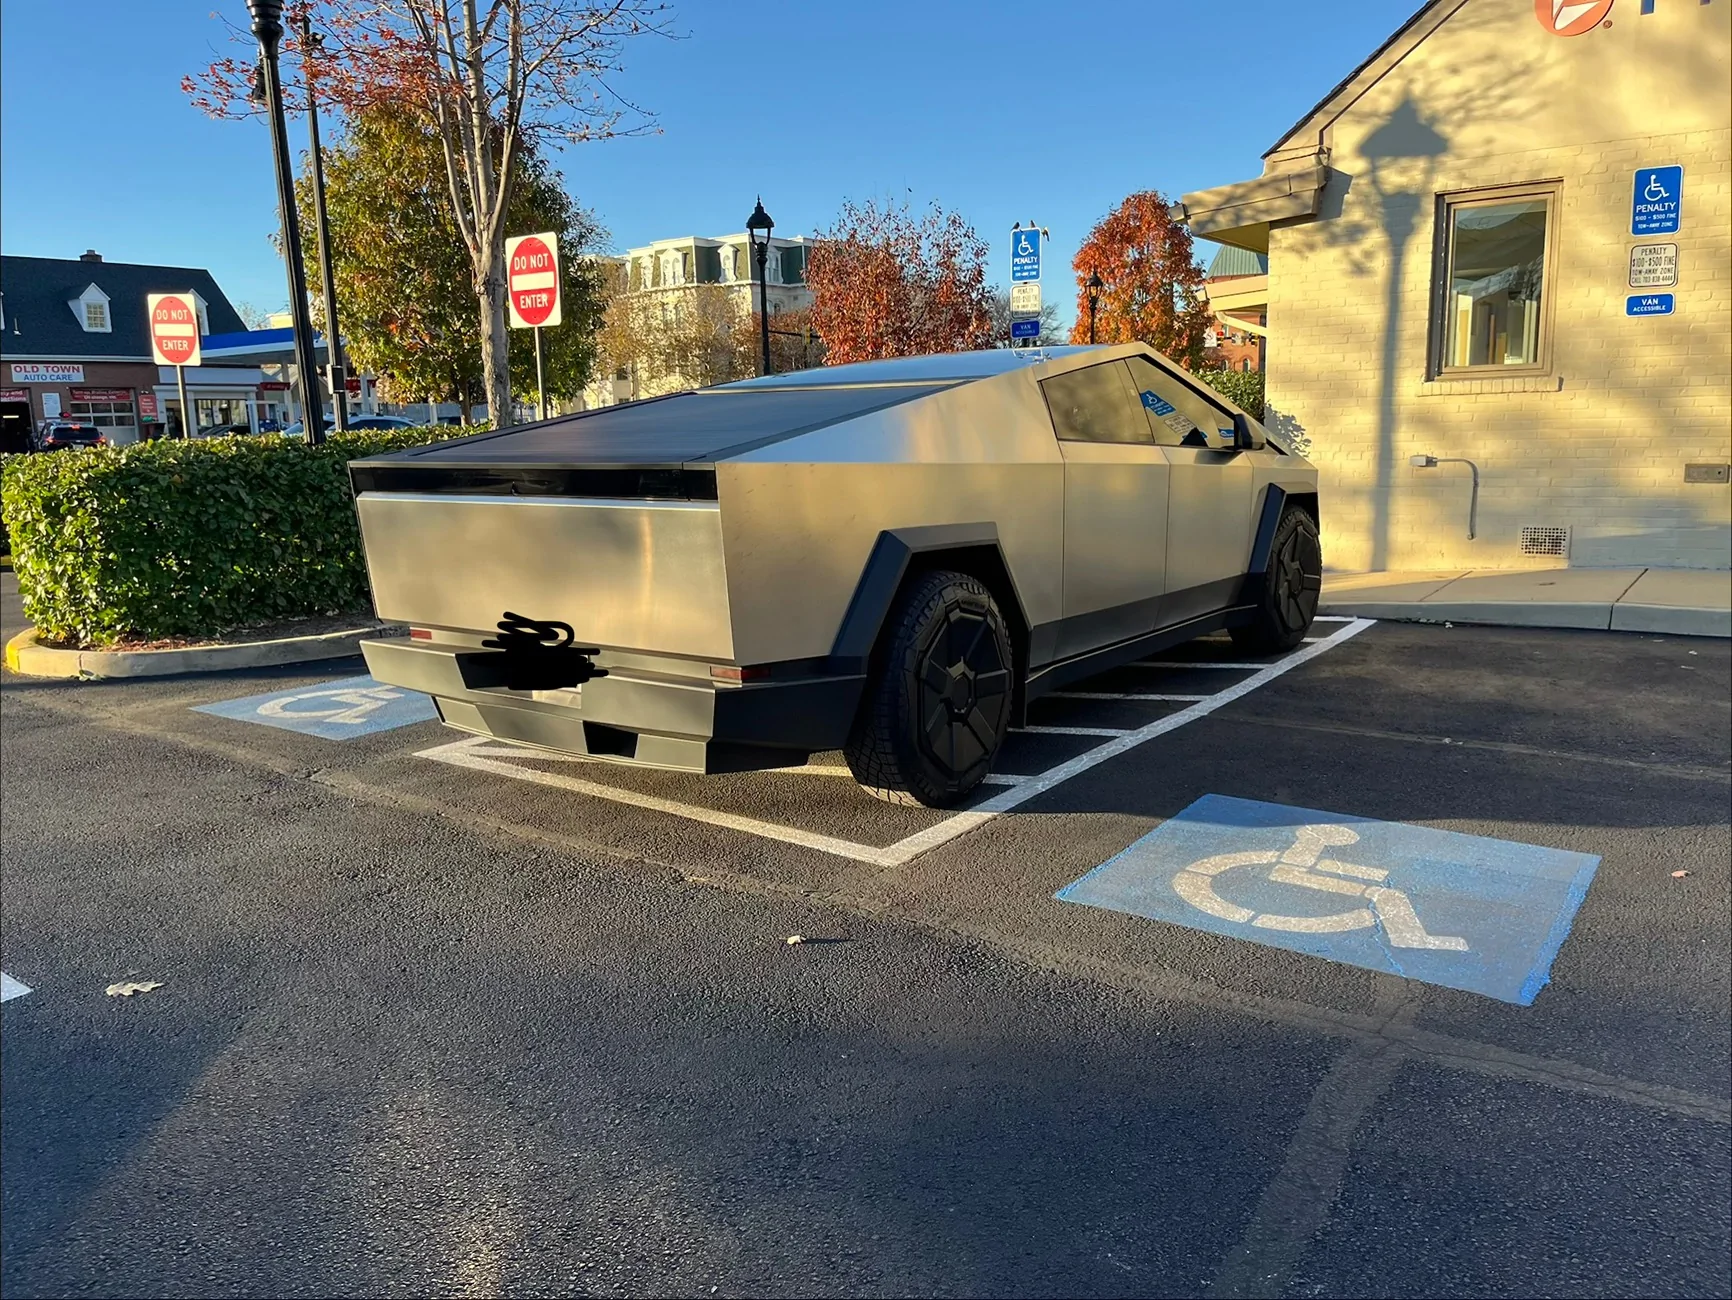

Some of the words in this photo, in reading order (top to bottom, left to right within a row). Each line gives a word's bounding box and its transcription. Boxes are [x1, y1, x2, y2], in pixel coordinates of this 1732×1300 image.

[1636, 202, 1677, 213] PENALTY
[1641, 247, 1667, 256] PENALTY
[513, 255, 527, 271] DO
[530, 253, 549, 269] NOT
[1013, 257, 1038, 265] PENALTY
[1664, 255, 1675, 266] FINE
[1660, 266, 1674, 275] ZONE
[520, 293, 549, 309] ENTER
[1641, 298, 1659, 306] VAN
[1632, 304, 1667, 312] ACCESSIBLE
[156, 309, 168, 320] DO
[171, 309, 188, 320] NOT
[162, 339, 189, 351] ENTER
[13, 365, 40, 373] OLD
[43, 365, 81, 373] TOWN
